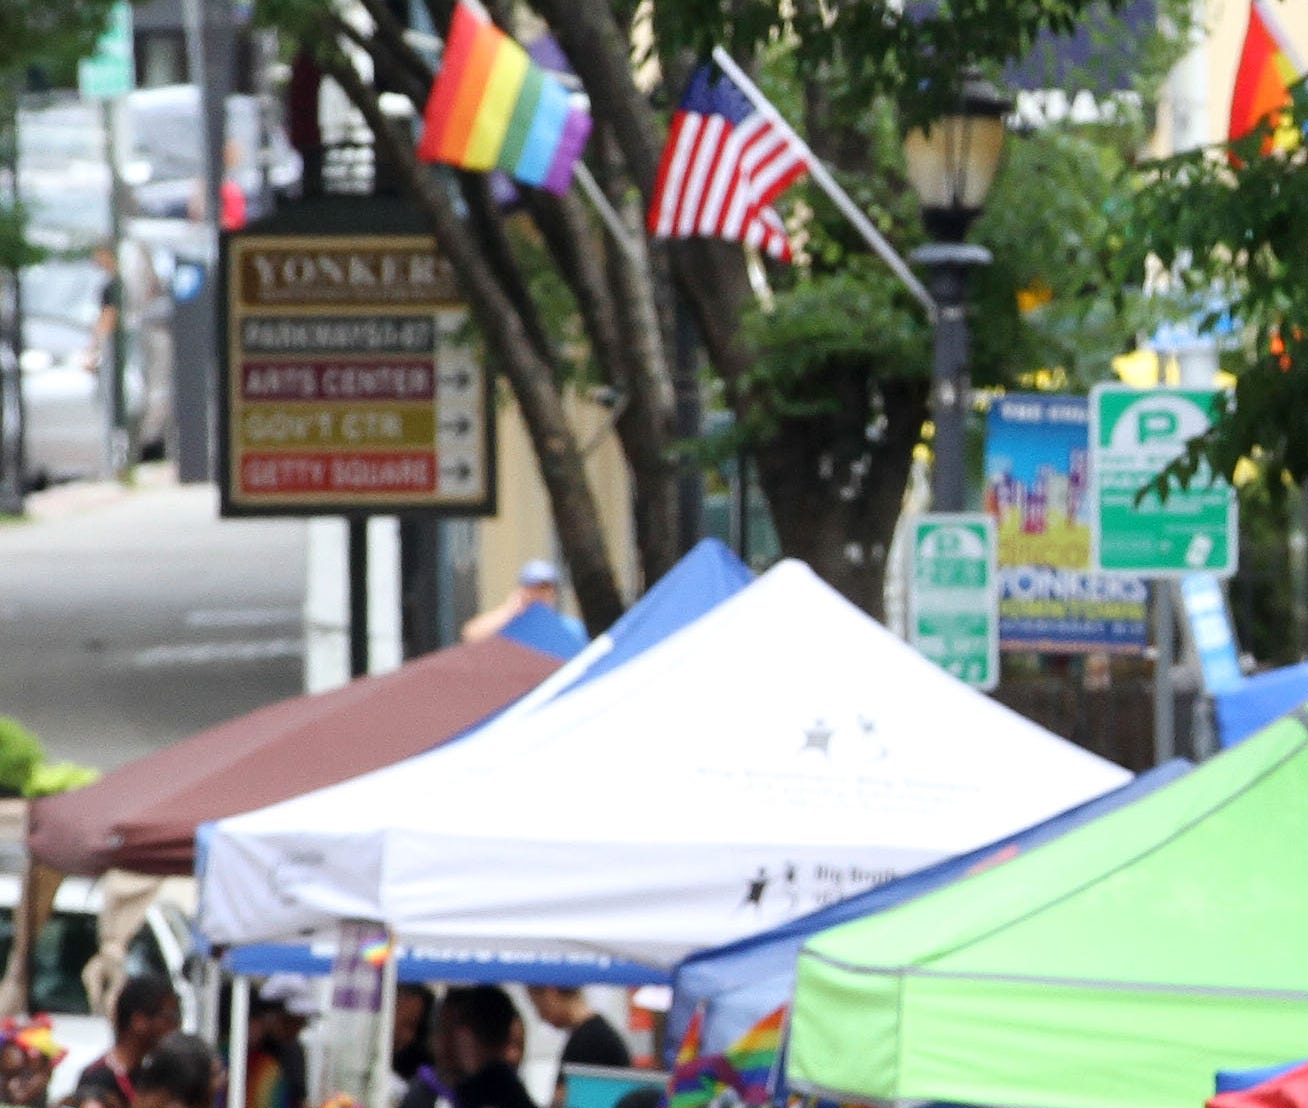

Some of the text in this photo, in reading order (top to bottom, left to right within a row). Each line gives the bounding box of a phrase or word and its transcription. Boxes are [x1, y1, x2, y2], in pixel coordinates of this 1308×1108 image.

[246, 367, 429, 396] ARTS CENTER
[340, 411, 402, 440] CTR
[245, 458, 429, 487] GETTY SQUARE
